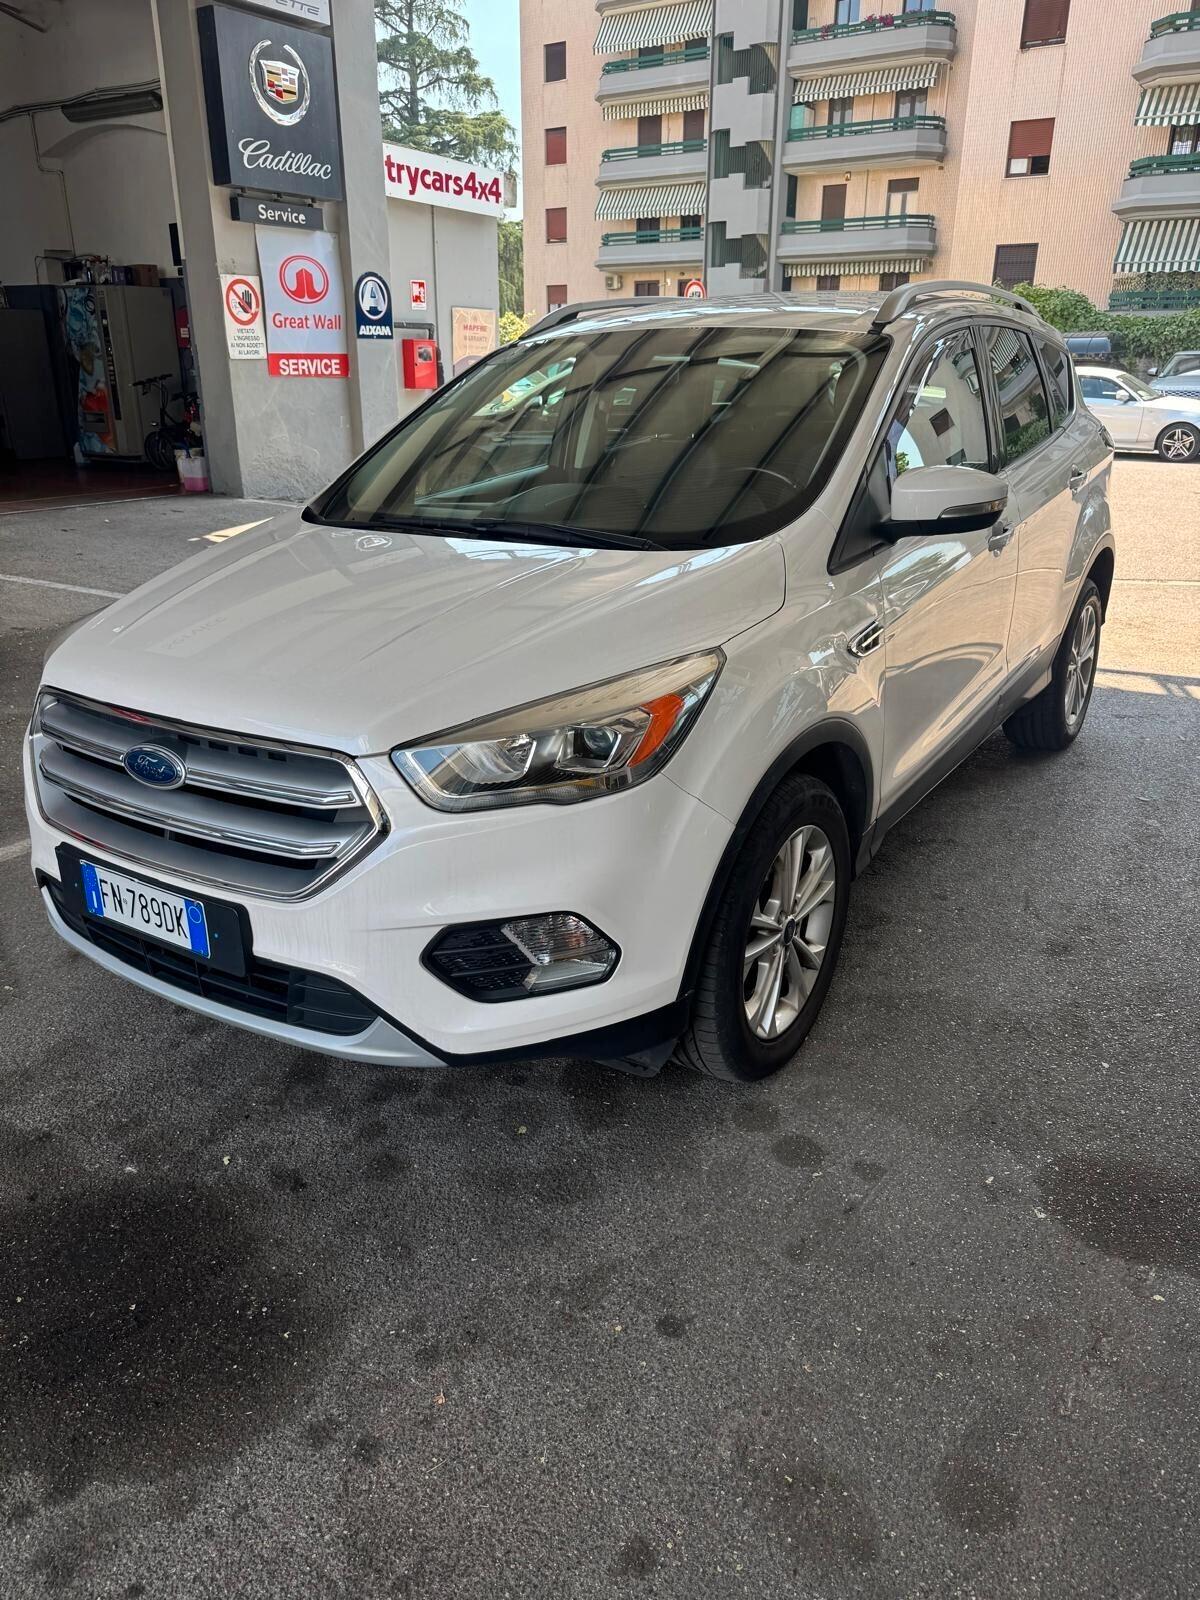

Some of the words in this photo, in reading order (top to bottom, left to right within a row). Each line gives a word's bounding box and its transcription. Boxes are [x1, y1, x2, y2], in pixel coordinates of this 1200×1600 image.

[238, 138, 332, 180] Cadillac
[384, 154, 502, 203] trycars4x4
[258, 204, 306, 224] Service
[272, 312, 310, 329] Great
[313, 314, 341, 330] Wall
[358, 325, 392, 336] AIXAM
[279, 358, 341, 376] SERVICE
